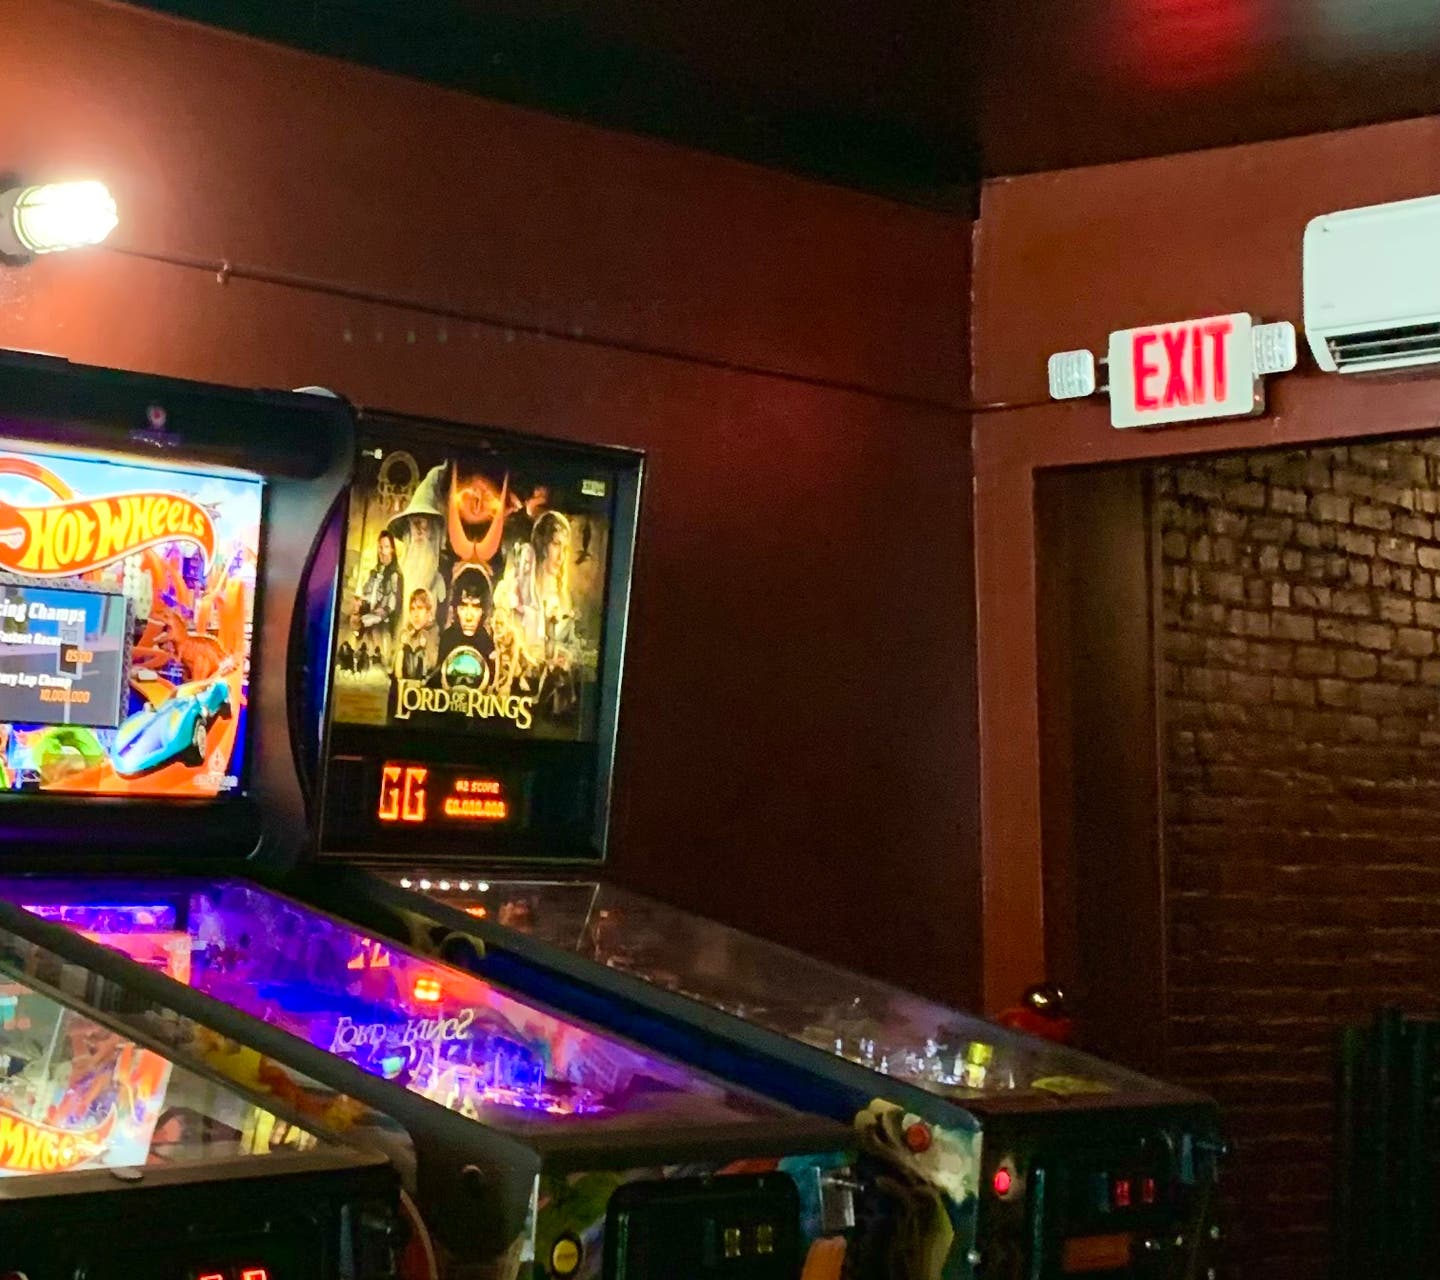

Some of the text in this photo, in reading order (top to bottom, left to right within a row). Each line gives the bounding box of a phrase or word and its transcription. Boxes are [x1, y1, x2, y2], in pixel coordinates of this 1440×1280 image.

[1132, 320, 1233, 412] EXIT
[16, 496, 205, 570] HOT WHEELS
[29, 602, 86, 625] Champs
[394, 678, 450, 720] LORD
[466, 688, 533, 729] RINGS
